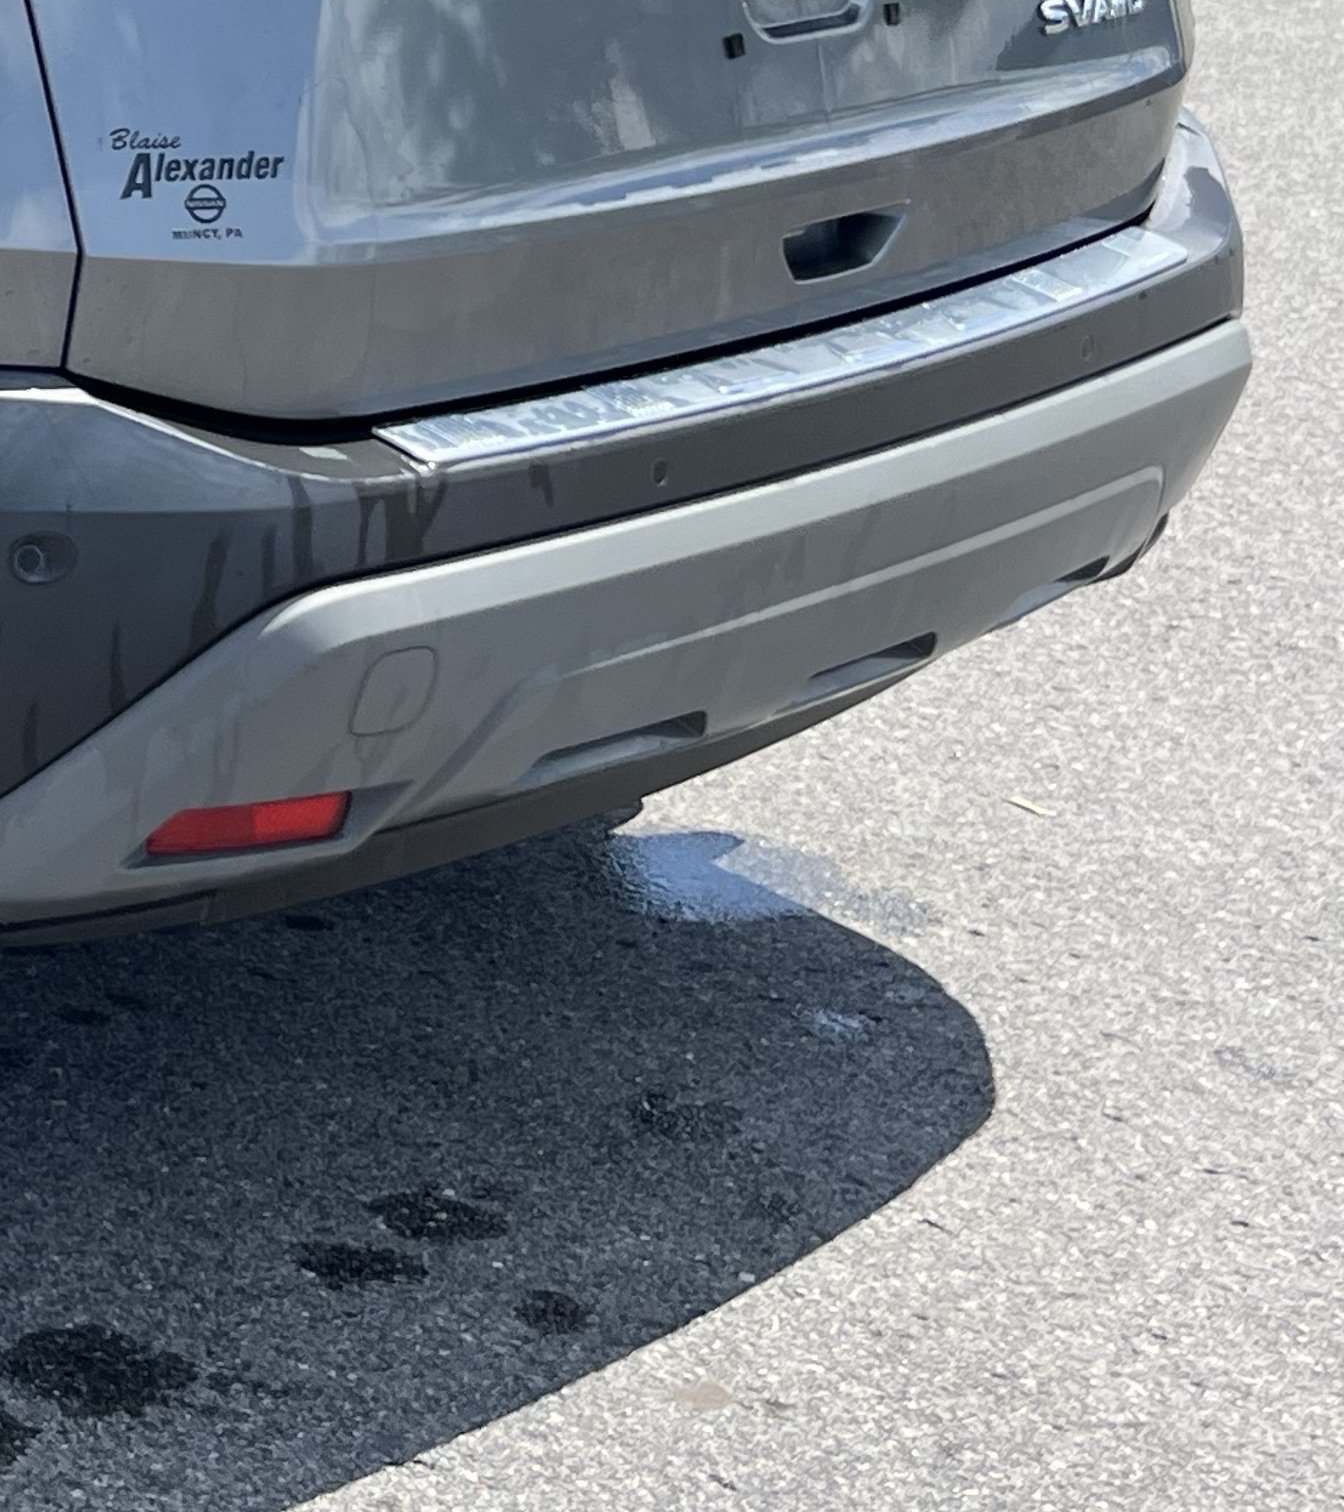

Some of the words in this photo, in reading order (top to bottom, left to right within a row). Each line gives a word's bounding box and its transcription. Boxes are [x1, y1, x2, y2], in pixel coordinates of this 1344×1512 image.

[109, 127, 182, 151] Blaise
[119, 149, 285, 200] Alexander
[225, 227, 244, 238] PA
